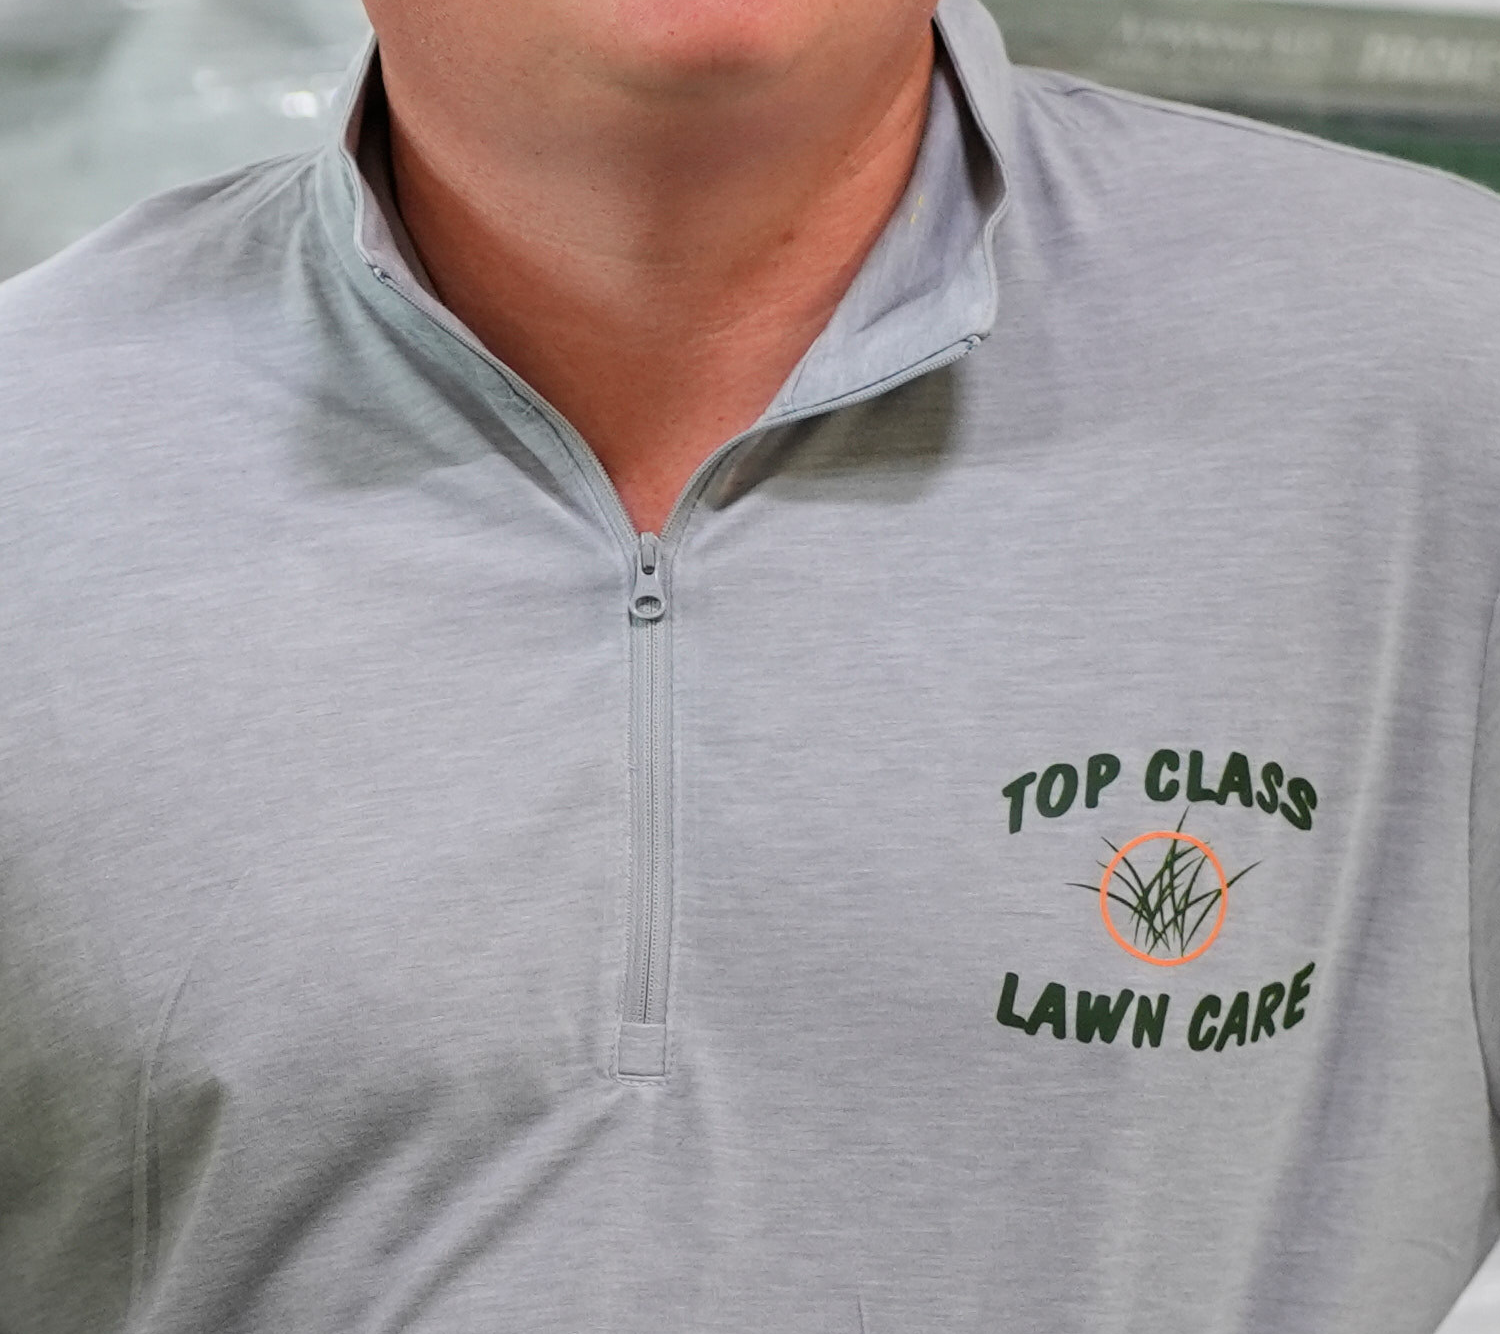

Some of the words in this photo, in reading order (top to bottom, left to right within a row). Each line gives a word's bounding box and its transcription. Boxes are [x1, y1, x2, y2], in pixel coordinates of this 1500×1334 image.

[1002, 753, 1121, 834] TOP
[1145, 748, 1317, 831] CLASS
[996, 972, 1170, 1049] LAWN
[1188, 961, 1316, 1053] CARE
